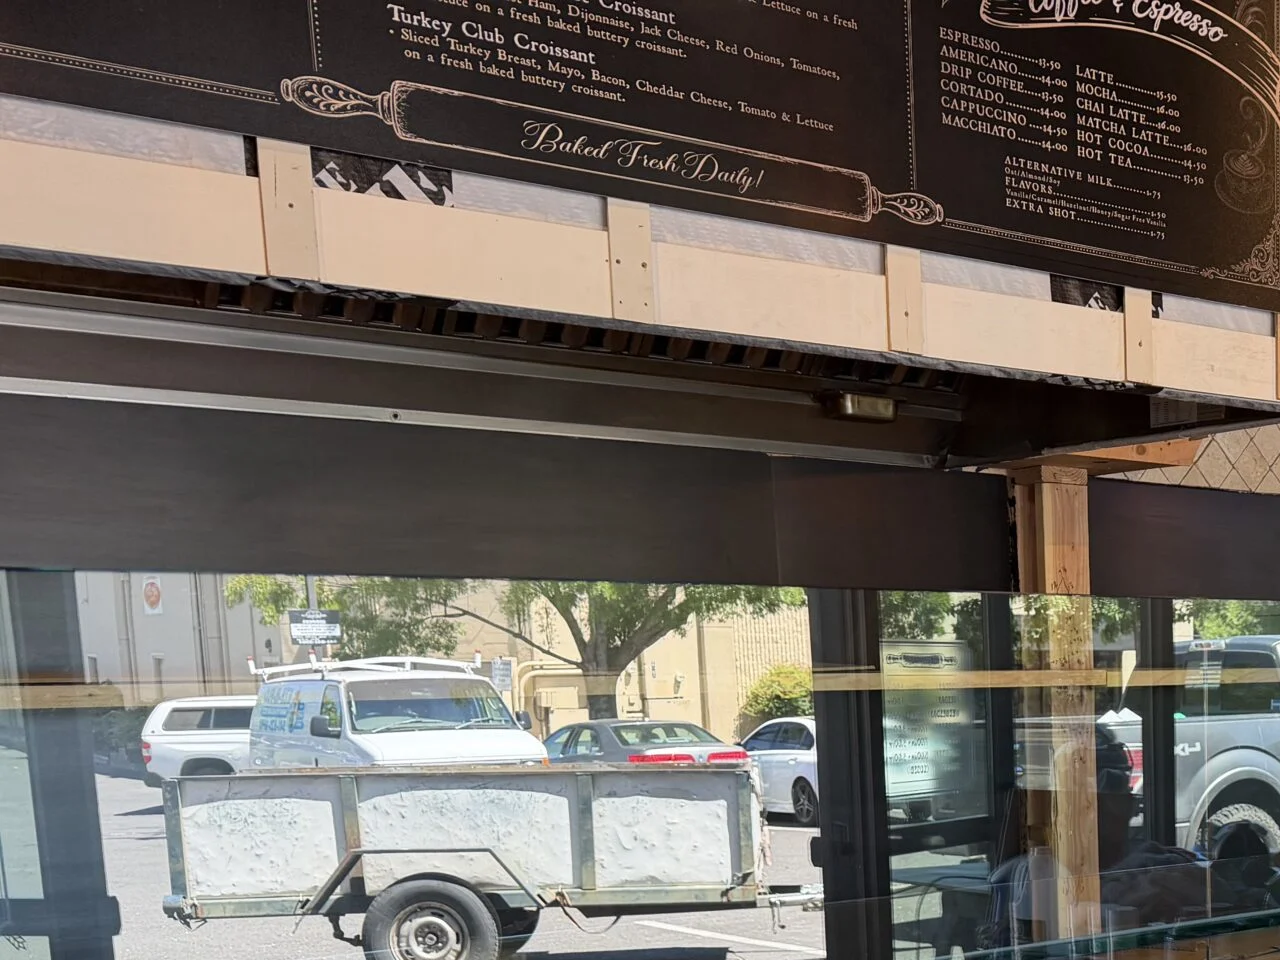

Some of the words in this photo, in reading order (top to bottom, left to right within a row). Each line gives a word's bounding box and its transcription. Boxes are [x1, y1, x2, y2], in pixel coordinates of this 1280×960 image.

[386, 3, 452, 36] Turkey
[461, 21, 504, 43] Club
[513, 32, 596, 64] Croissant
[475, 2, 491, 13] on
[497, 7, 505, 16] a
[510, 8, 541, 24] fresh
[547, 15, 580, 33] baked
[587, 25, 629, 47] buttery
[635, 37, 687, 58] croissant.
[806, 10, 819, 21] on
[823, 14, 830, 23] a
[833, 14, 857, 30] fresh
[1132, 0, 1228, 41] Espresso
[567, 4, 634, 31] Dijonnaise,
[640, 21, 661, 37] Jack
[666, 28, 709, 49] Cheese,
[715, 39, 737, 55] Red
[743, 47, 784, 67] Onions,
[789, 56, 840, 80] Tomatoes,
[400, 28, 439, 46] Sliced
[446, 37, 491, 60] Turkey
[497, 48, 541, 70] Breast,
[547, 59, 585, 80] Mayo,
[590, 68, 630, 89] Bacon,
[635, 78, 685, 100] Cheddar
[690, 90, 732, 111] Cheese,
[737, 100, 776, 119] Tomato
[781, 112, 791, 123] &
[795, 113, 834, 132] Lettuce
[403, 49, 421, 61] on
[427, 54, 435, 63] a
[440, 53, 473, 70] fresh
[479, 61, 515, 79] baked
[520, 70, 565, 92] buttery
[571, 83, 625, 102] croissant.
[940, 61, 972, 79] DRIP
[940, 95, 1027, 126] CAPPUCCINO
[1076, 97, 1105, 115] CHAI
[941, 112, 1016, 140] MACCHIATO
[1076, 114, 1125, 136] MATCHA
[1076, 129, 1101, 146] HOT
[520, 120, 613, 158] Baked
[615, 138, 680, 172] Fresh
[680, 151, 764, 193] Daily!
[1077, 145, 1101, 161] HOT
[1004, 155, 1083, 181] ALTERNATIVE
[1004, 167, 1060, 186] Oat/Almond/Soy
[1005, 197, 1043, 215] EXTRA
